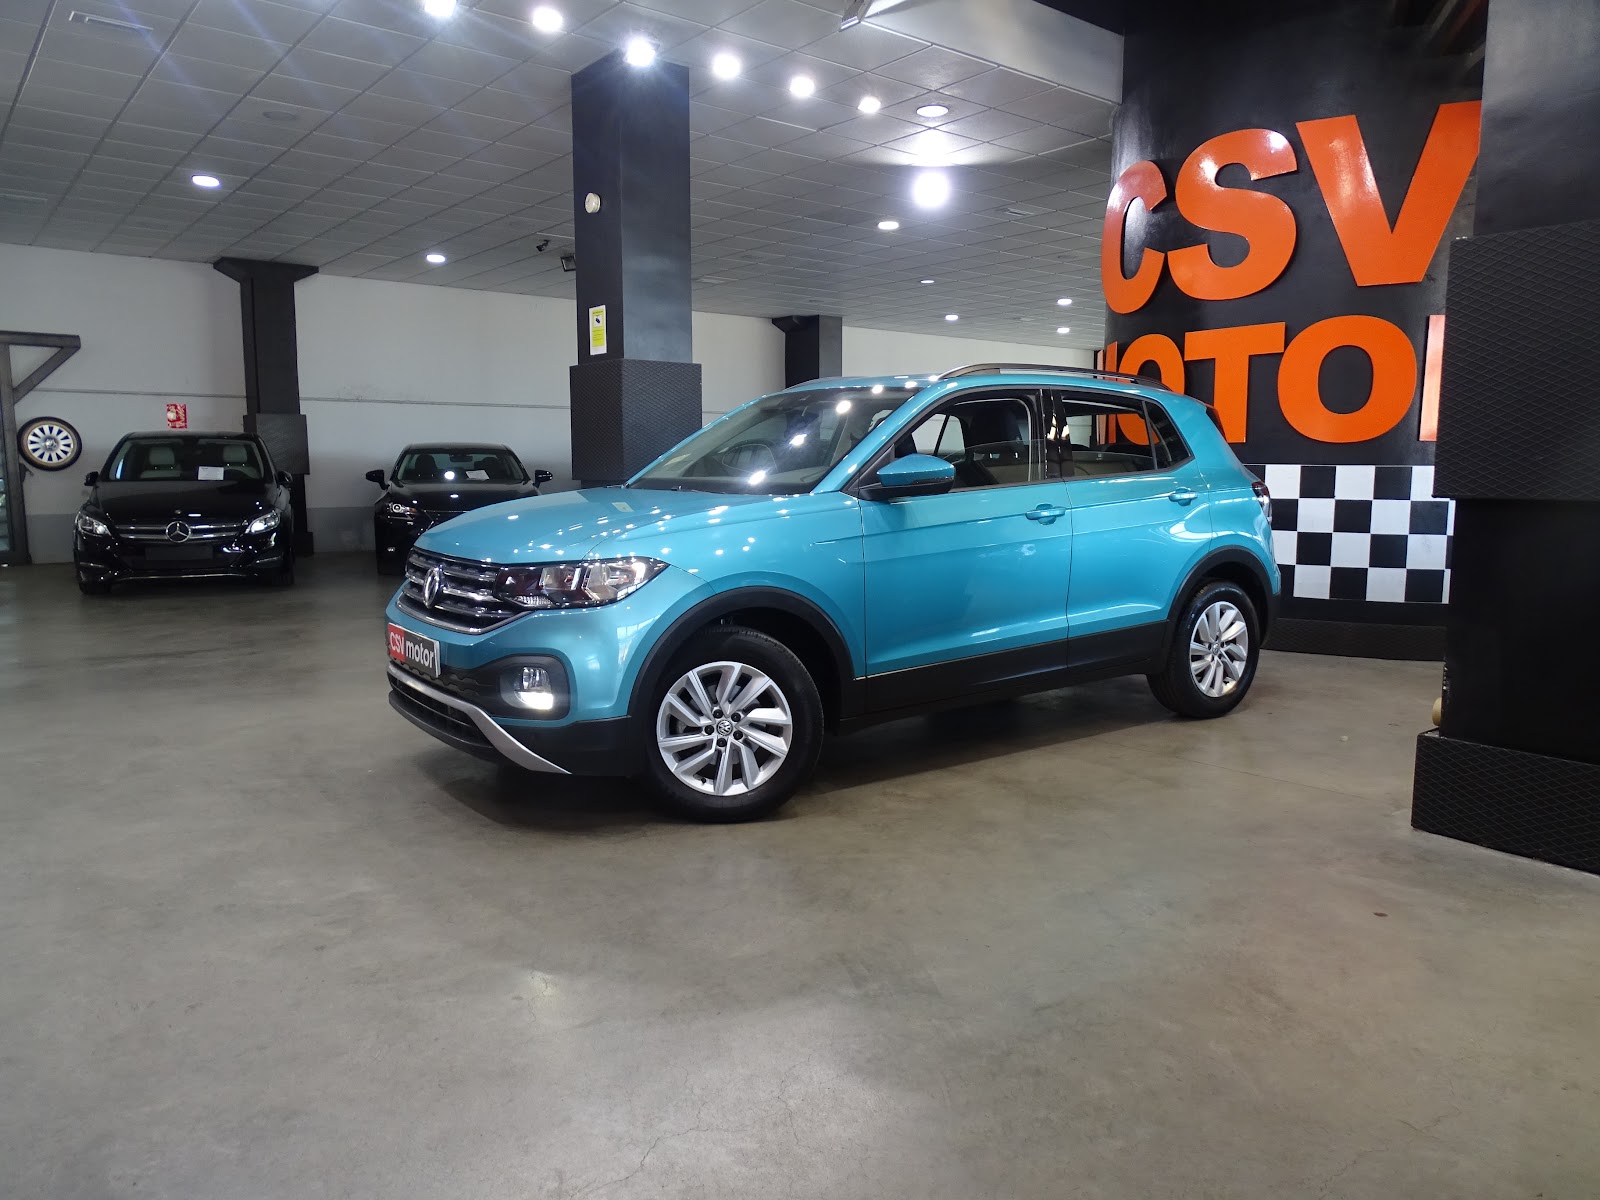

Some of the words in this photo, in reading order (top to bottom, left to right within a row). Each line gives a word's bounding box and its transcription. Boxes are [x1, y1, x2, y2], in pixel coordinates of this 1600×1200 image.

[1102, 100, 1481, 314] CSV
[1098, 314, 1446, 445] OTO
[390, 631, 404, 655] CSV
[405, 640, 434, 669] motor
